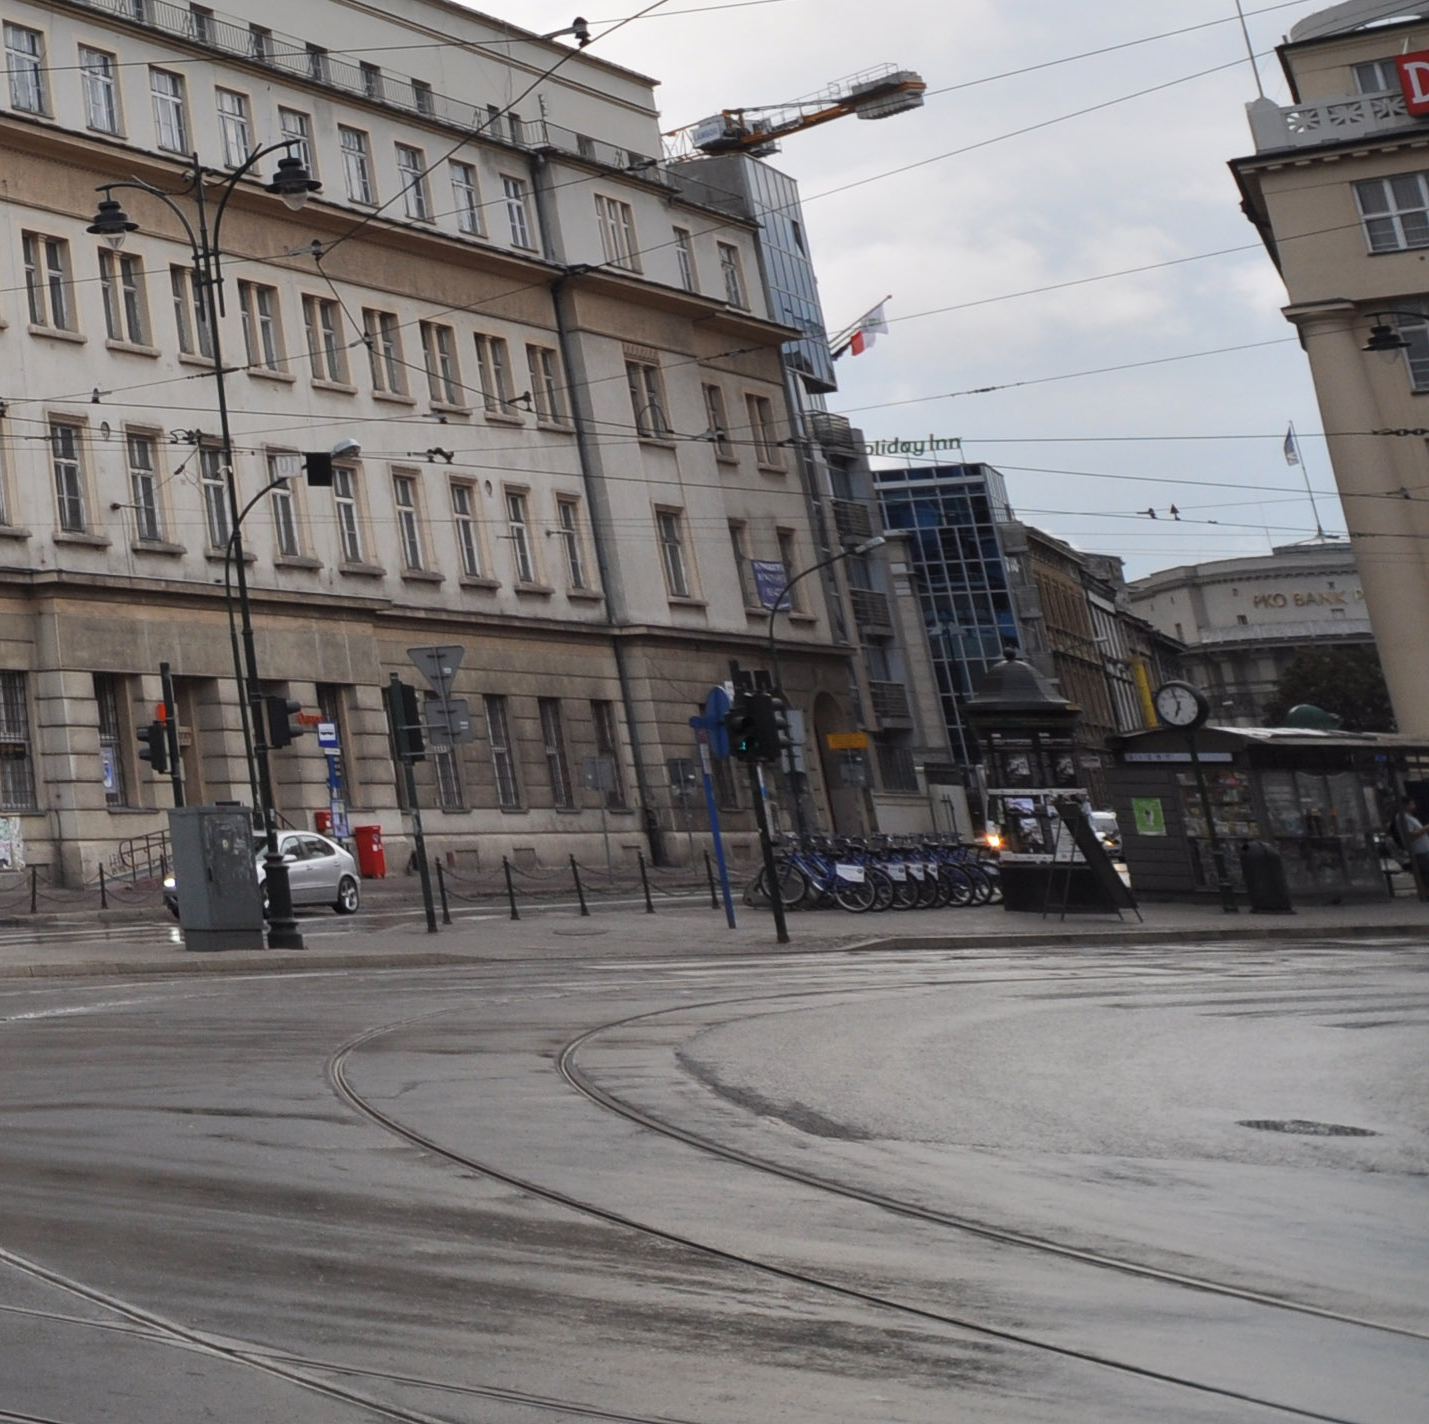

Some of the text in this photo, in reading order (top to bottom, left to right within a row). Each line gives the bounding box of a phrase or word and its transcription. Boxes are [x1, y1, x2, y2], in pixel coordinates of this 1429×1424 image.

[864, 433, 962, 456] oliday Inn
[1253, 593, 1287, 608] PKO
[1293, 591, 1349, 607] BANK
